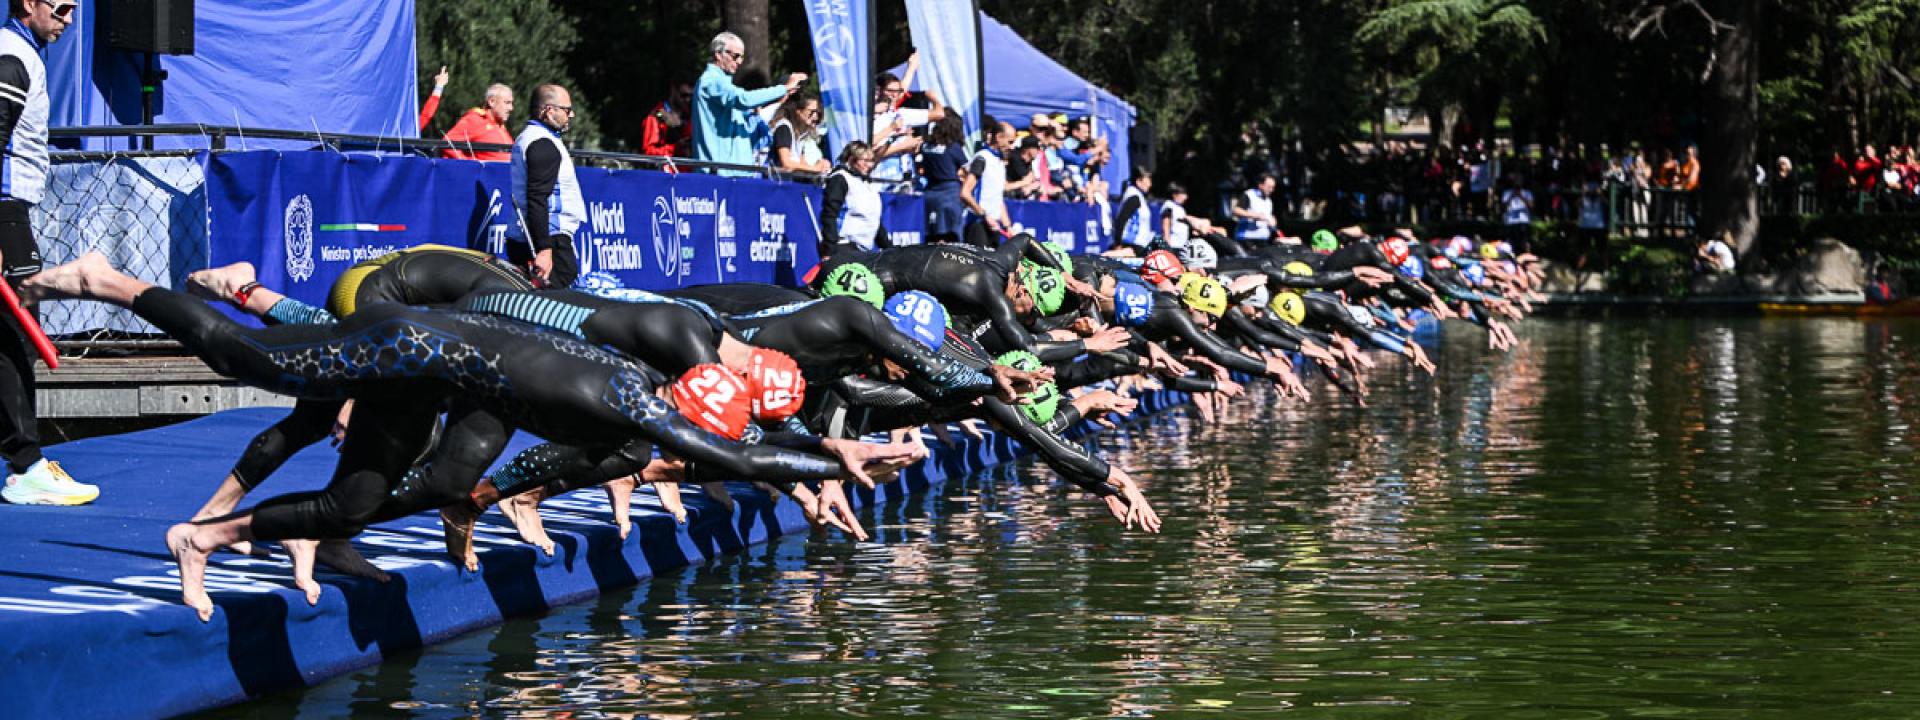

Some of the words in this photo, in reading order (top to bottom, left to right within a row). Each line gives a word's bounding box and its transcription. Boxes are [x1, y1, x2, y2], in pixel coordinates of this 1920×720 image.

[590, 202, 625, 235] World
[321, 246, 351, 261] Ministro
[594, 239, 642, 269] Triathlon
[895, 294, 934, 325] 38
[687, 369, 736, 414] 22
[763, 367, 793, 411] 29
